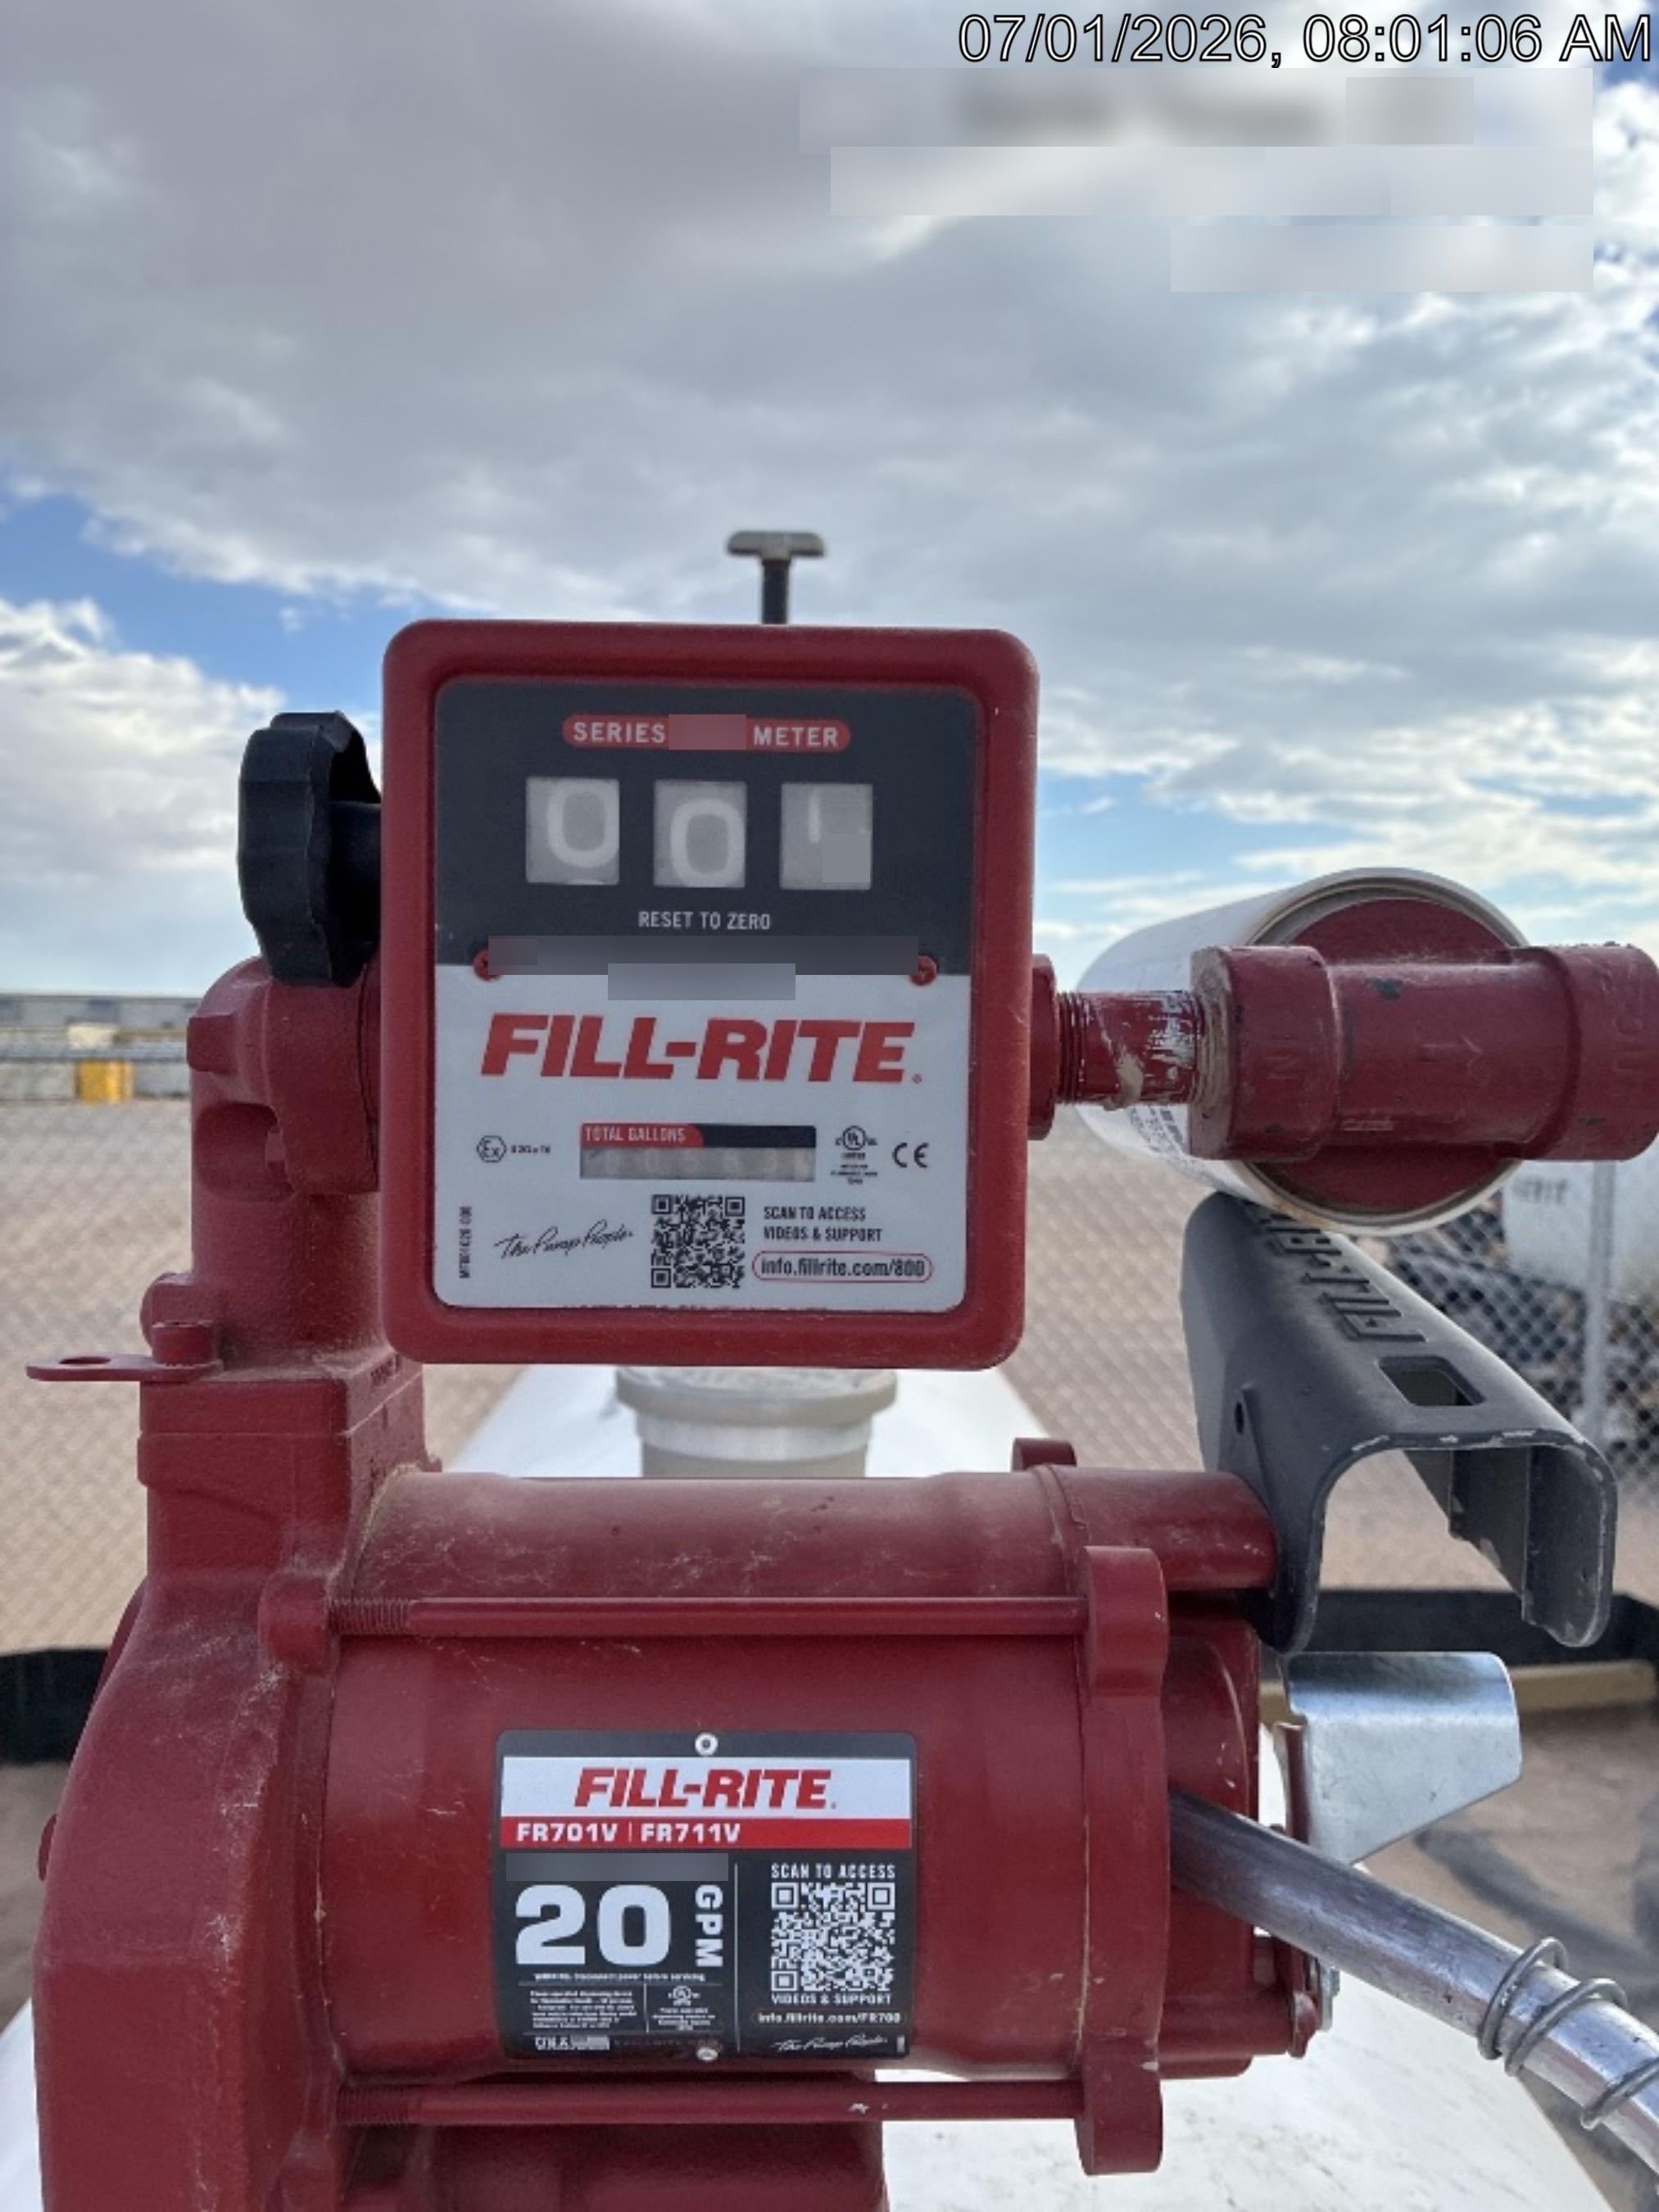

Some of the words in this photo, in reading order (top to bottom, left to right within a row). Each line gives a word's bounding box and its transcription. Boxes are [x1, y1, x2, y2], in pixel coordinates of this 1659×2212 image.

[573, 722, 666, 744] SERIES
[753, 726, 839, 747] METER
[638, 910, 693, 929] RESET
[700, 911, 721, 930] TO
[727, 912, 771, 931] ZERO
[480, 1013, 915, 1084] FILL-RITE
[585, 1126, 623, 1142] TOTAL
[628, 1127, 686, 1143] GALLONS
[763, 1206, 797, 1220] SCAN
[798, 1206, 814, 1220] TO
[818, 1206, 866, 1222] ACCESS
[763, 1226, 808, 1240] VIDEOS
[825, 1227, 882, 1242] SUPPORT
[573, 1767, 832, 1810] FILL-RITE
[516, 1822, 618, 1843] FR701V
[641, 1822, 741, 1843] FR711V
[771, 1862, 809, 1879] SCAN
[814, 1862, 832, 1879] TO
[837, 1863, 895, 1879] ACCESS
[515, 1884, 672, 1966] 20
[695, 1884, 723, 1967] GPM
[771, 1992, 817, 2005] VIDEOS
[833, 1992, 892, 2005] SUPPORT
